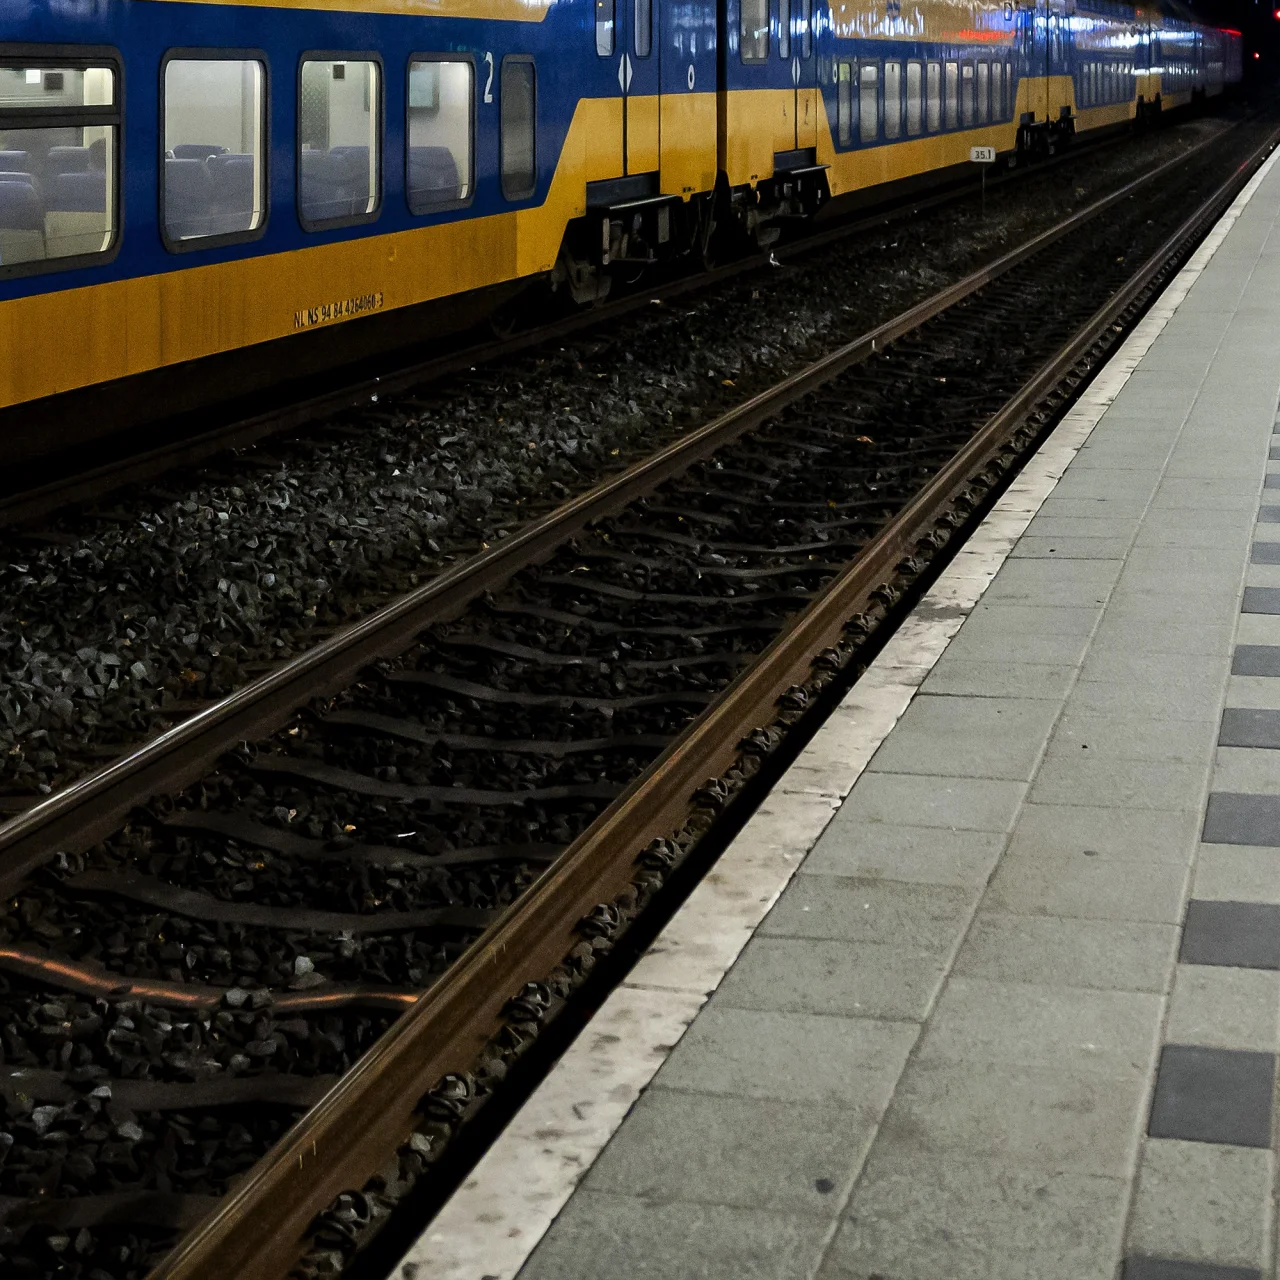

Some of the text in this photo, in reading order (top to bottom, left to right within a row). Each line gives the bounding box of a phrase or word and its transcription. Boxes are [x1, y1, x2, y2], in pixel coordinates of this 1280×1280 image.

[484, 51, 494, 103] 2
[293, 310, 305, 329] NL
[307, 307, 319, 326] NS
[321, 304, 331, 322] 94
[333, 301, 343, 319] 84
